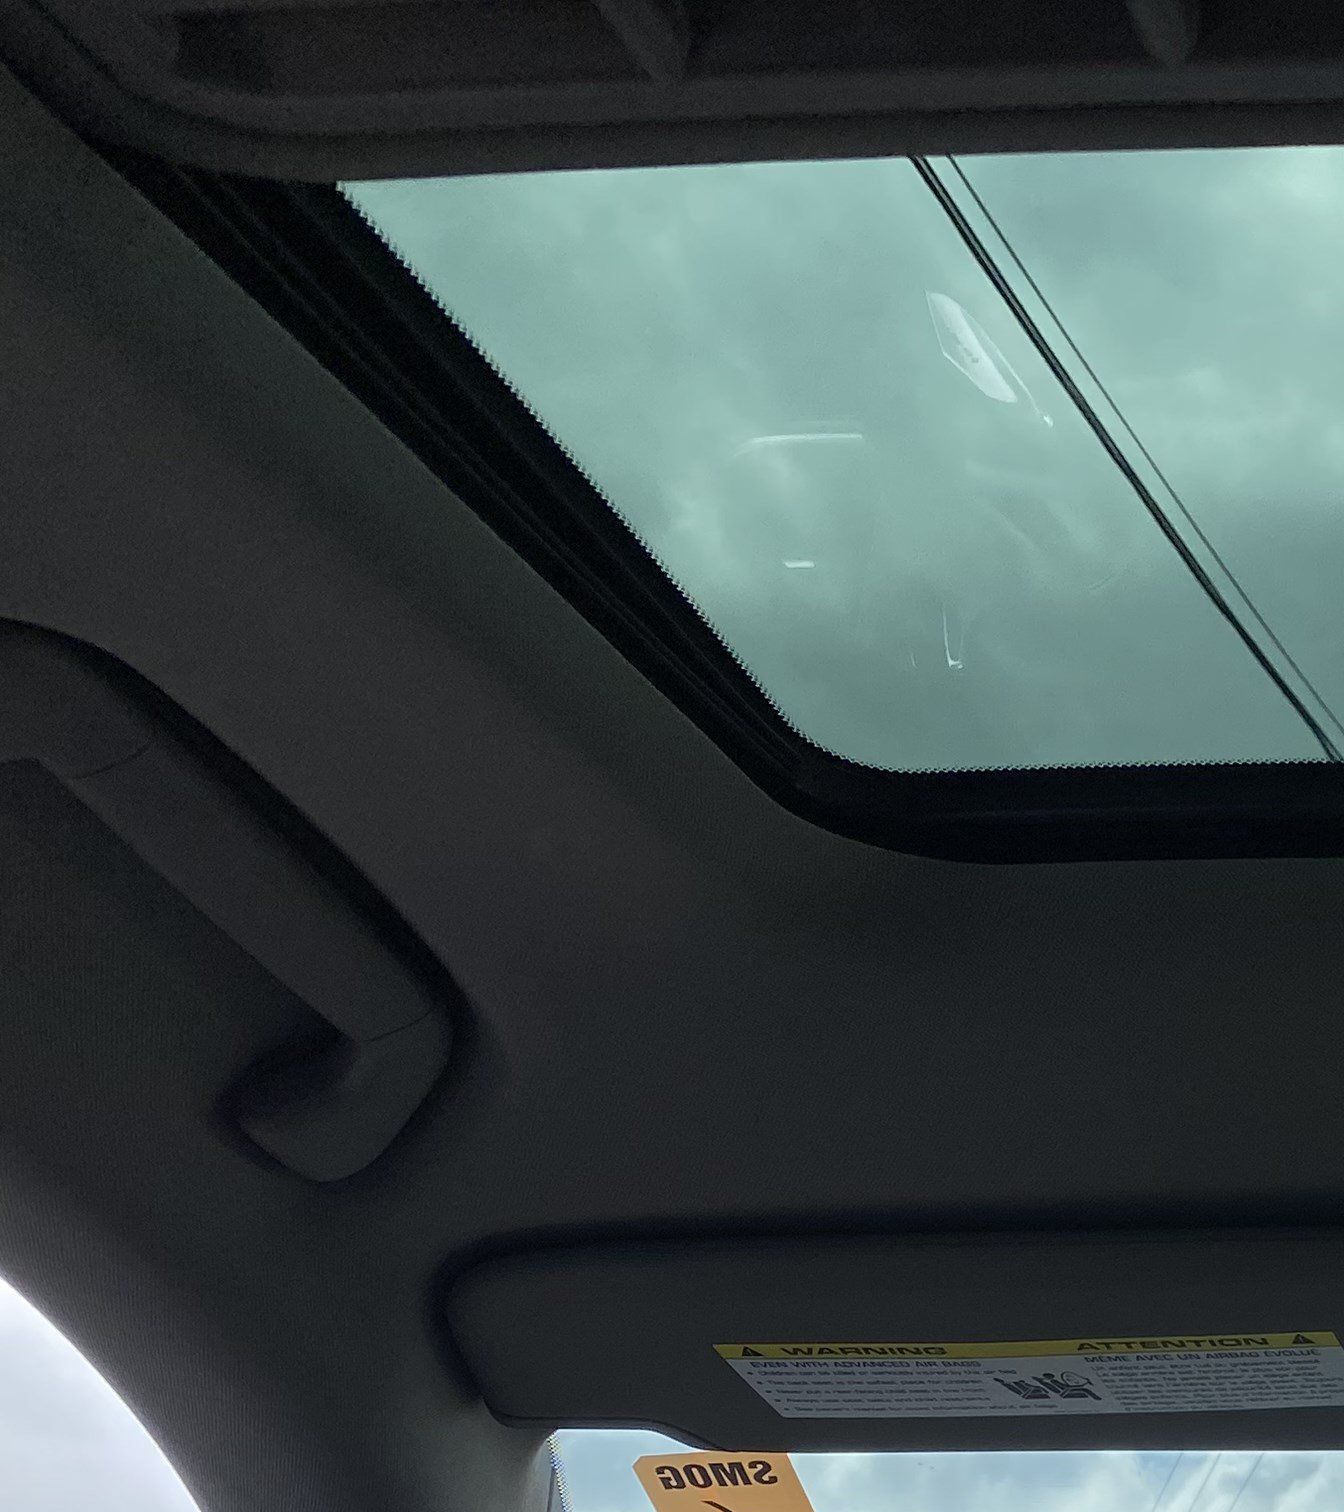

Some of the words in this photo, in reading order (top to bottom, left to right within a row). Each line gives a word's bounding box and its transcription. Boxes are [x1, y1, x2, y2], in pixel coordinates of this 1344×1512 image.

[1077, 1336, 1270, 1351] ATTENTION
[780, 1347, 948, 1356] WARNING
[832, 1360, 911, 1368] ADVANCED
